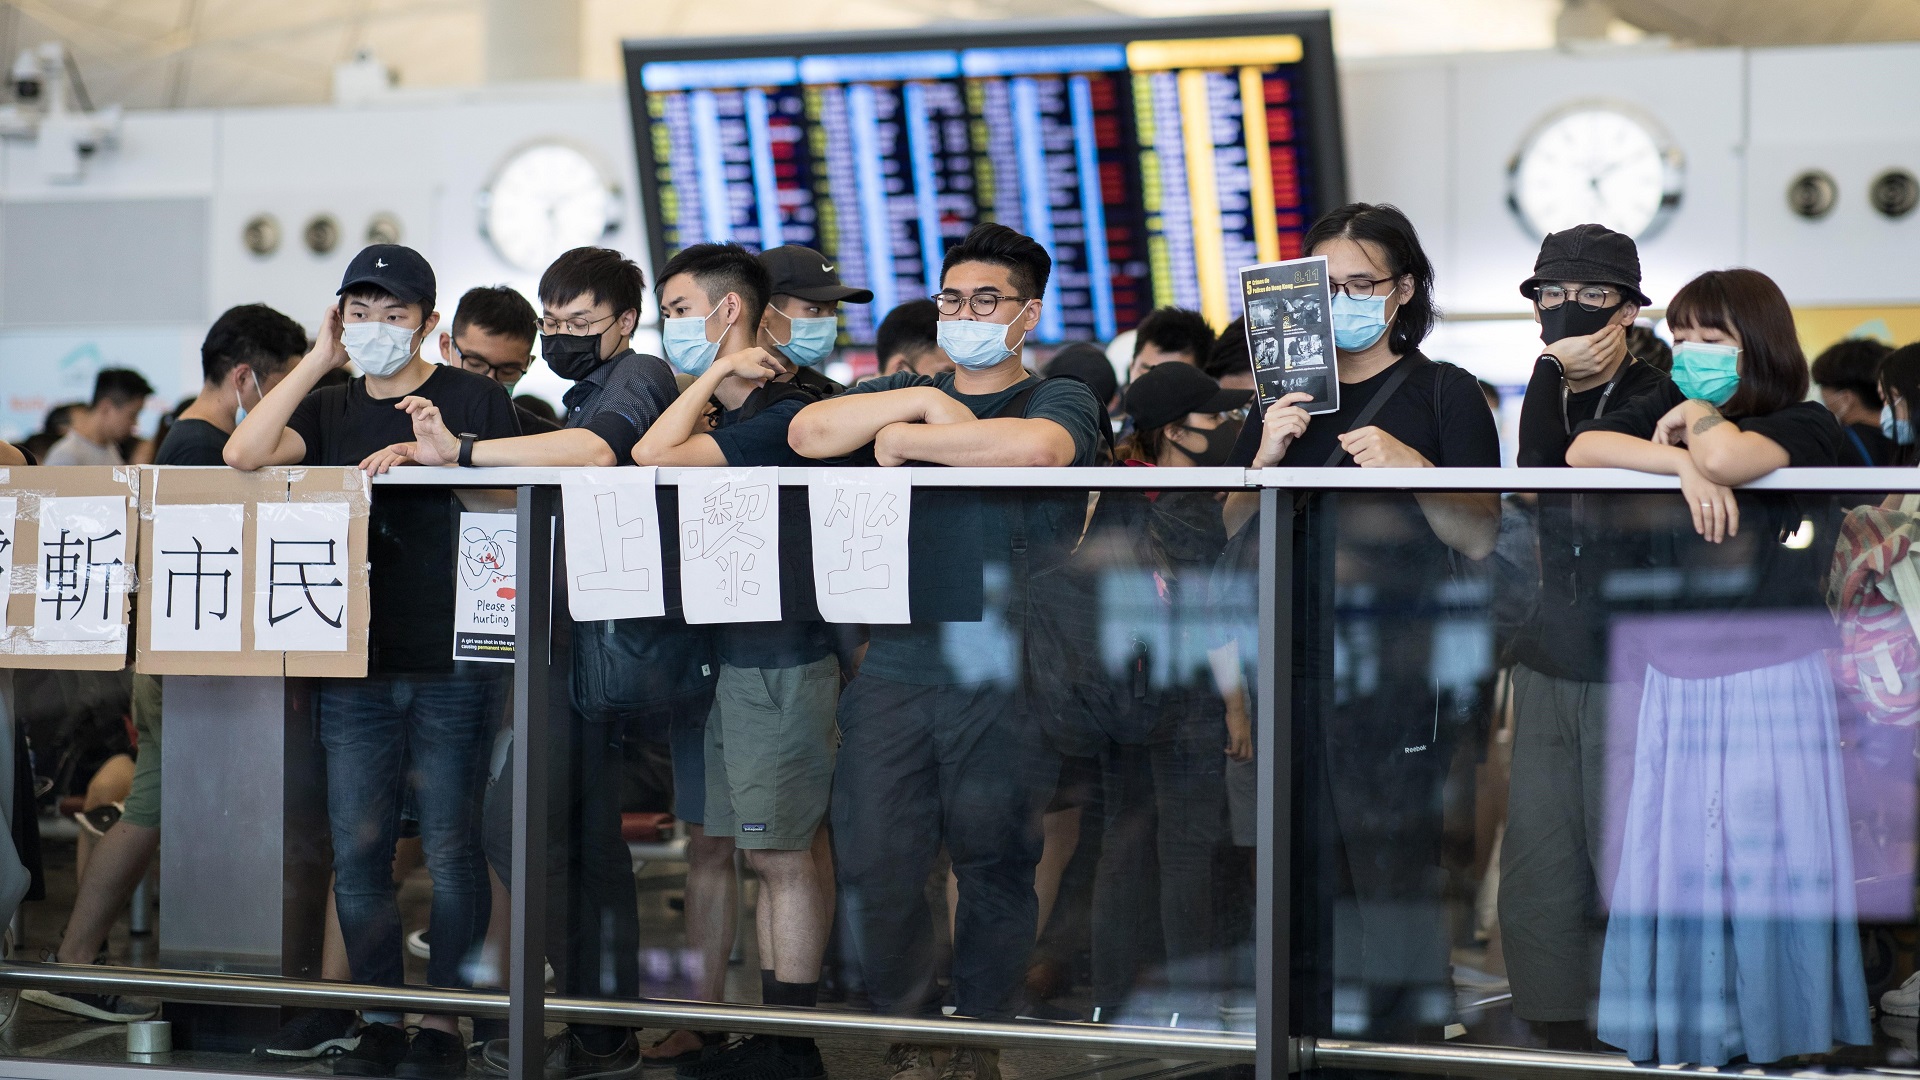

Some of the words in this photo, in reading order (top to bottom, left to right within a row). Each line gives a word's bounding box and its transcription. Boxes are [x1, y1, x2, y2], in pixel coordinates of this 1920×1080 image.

[1294, 268, 1319, 284] 8.11
[1246, 280, 1252, 295] 5
[161, 536, 343, 631] 市民
[477, 599, 505, 611] Please
[473, 612, 509, 627] hurting
[1405, 745, 1427, 753] Reebok
